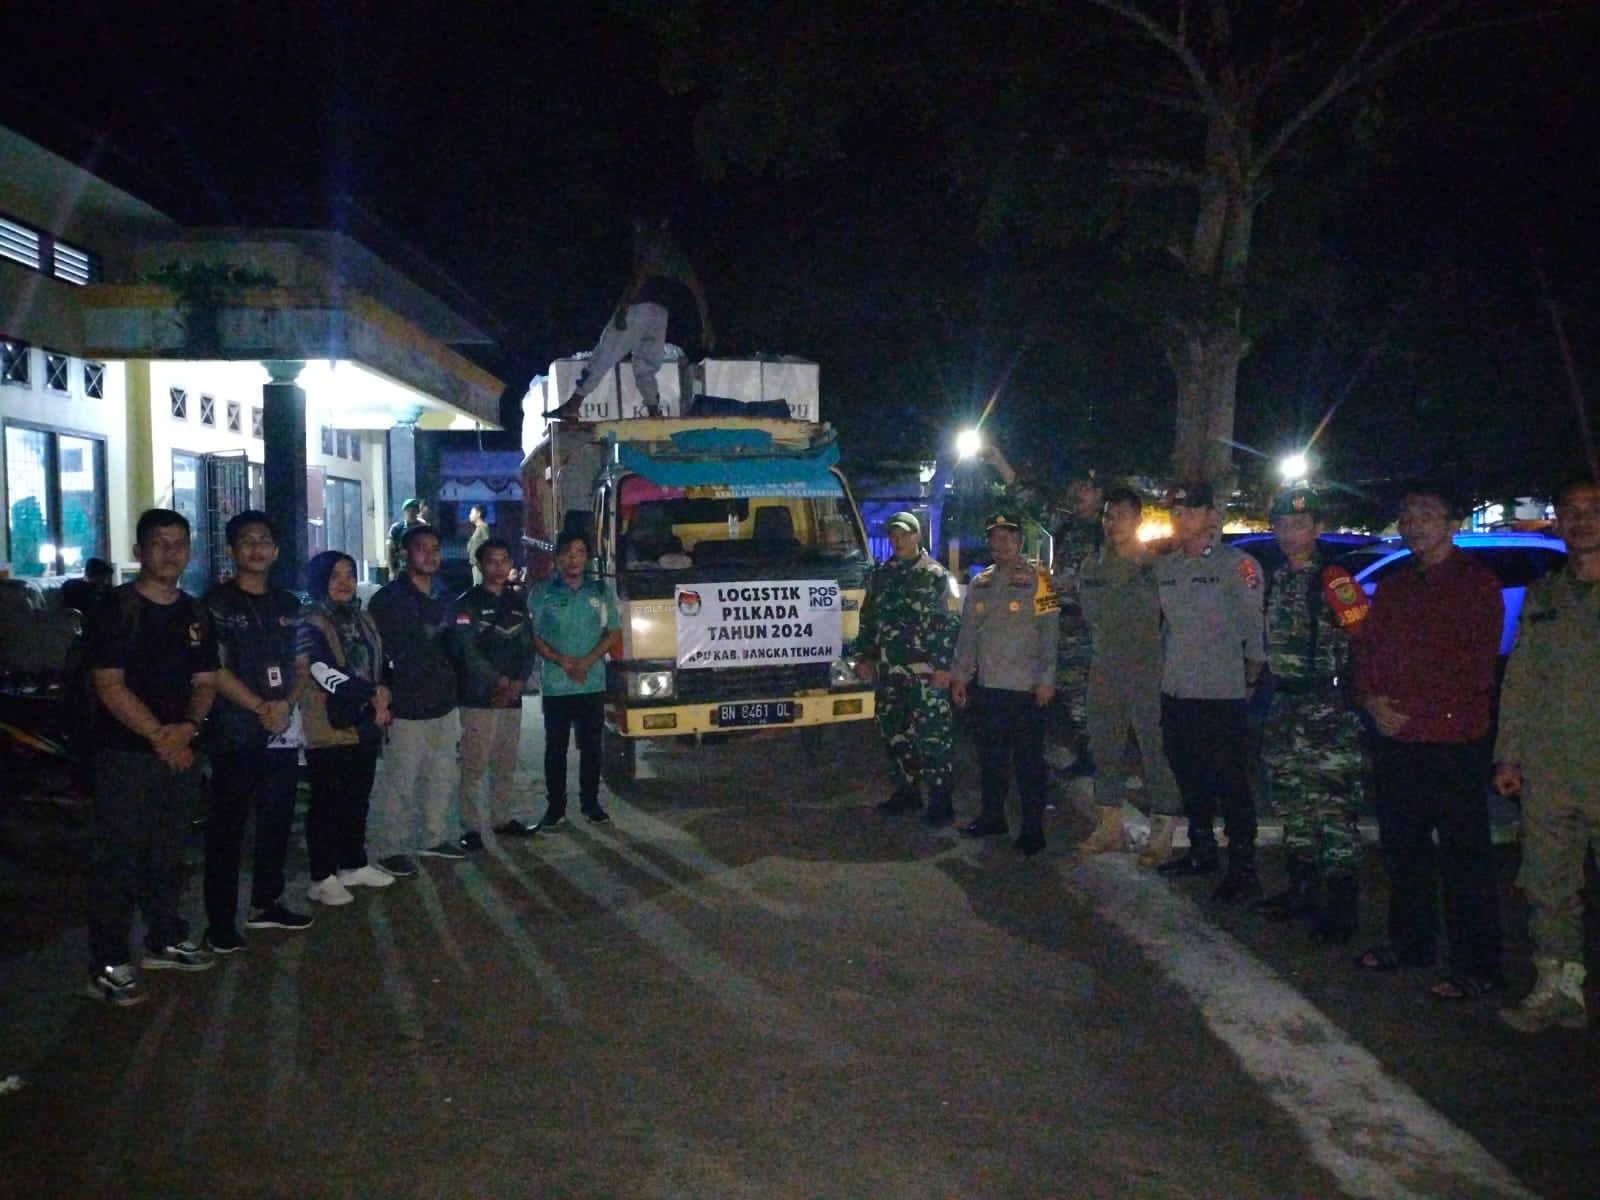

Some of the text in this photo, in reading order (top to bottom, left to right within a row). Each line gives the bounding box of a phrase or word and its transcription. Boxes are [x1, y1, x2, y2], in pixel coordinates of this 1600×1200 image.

[717, 587, 801, 602] LOGISTIK
[808, 586, 838, 597] POS
[722, 605, 799, 621] PILKADA
[708, 623, 813, 640] TAHUN 2024
[742, 647, 788, 660] BANGKA
[791, 646, 833, 657] TENGAH
[721, 704, 736, 720] BN
